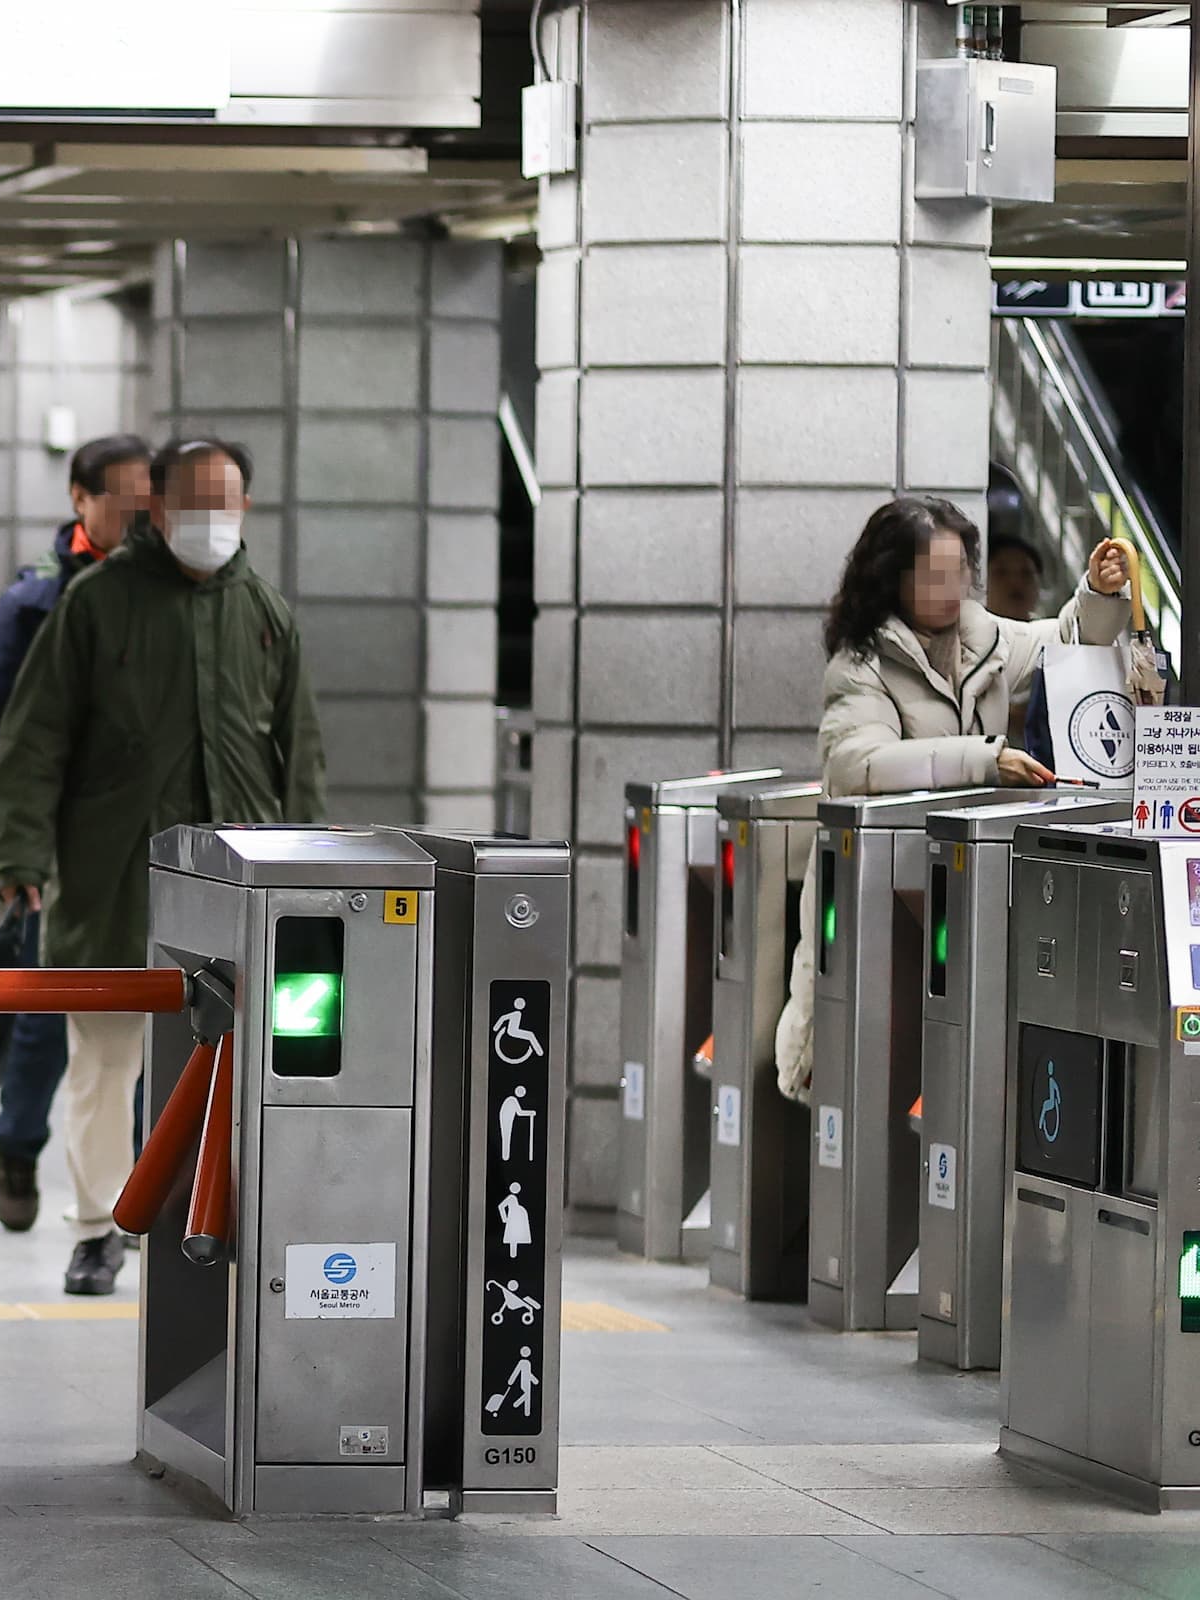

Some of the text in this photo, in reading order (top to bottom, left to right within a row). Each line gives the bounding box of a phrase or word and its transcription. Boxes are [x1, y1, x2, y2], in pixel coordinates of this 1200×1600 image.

[1164, 711, 1192, 722] 화장실
[1143, 727, 1162, 739] 그냥
[1137, 743, 1183, 755] 이용하시면
[395, 898, 407, 916] 5
[310, 1289, 369, 1300] 서울교통공사
[485, 1447, 536, 1465] G150
